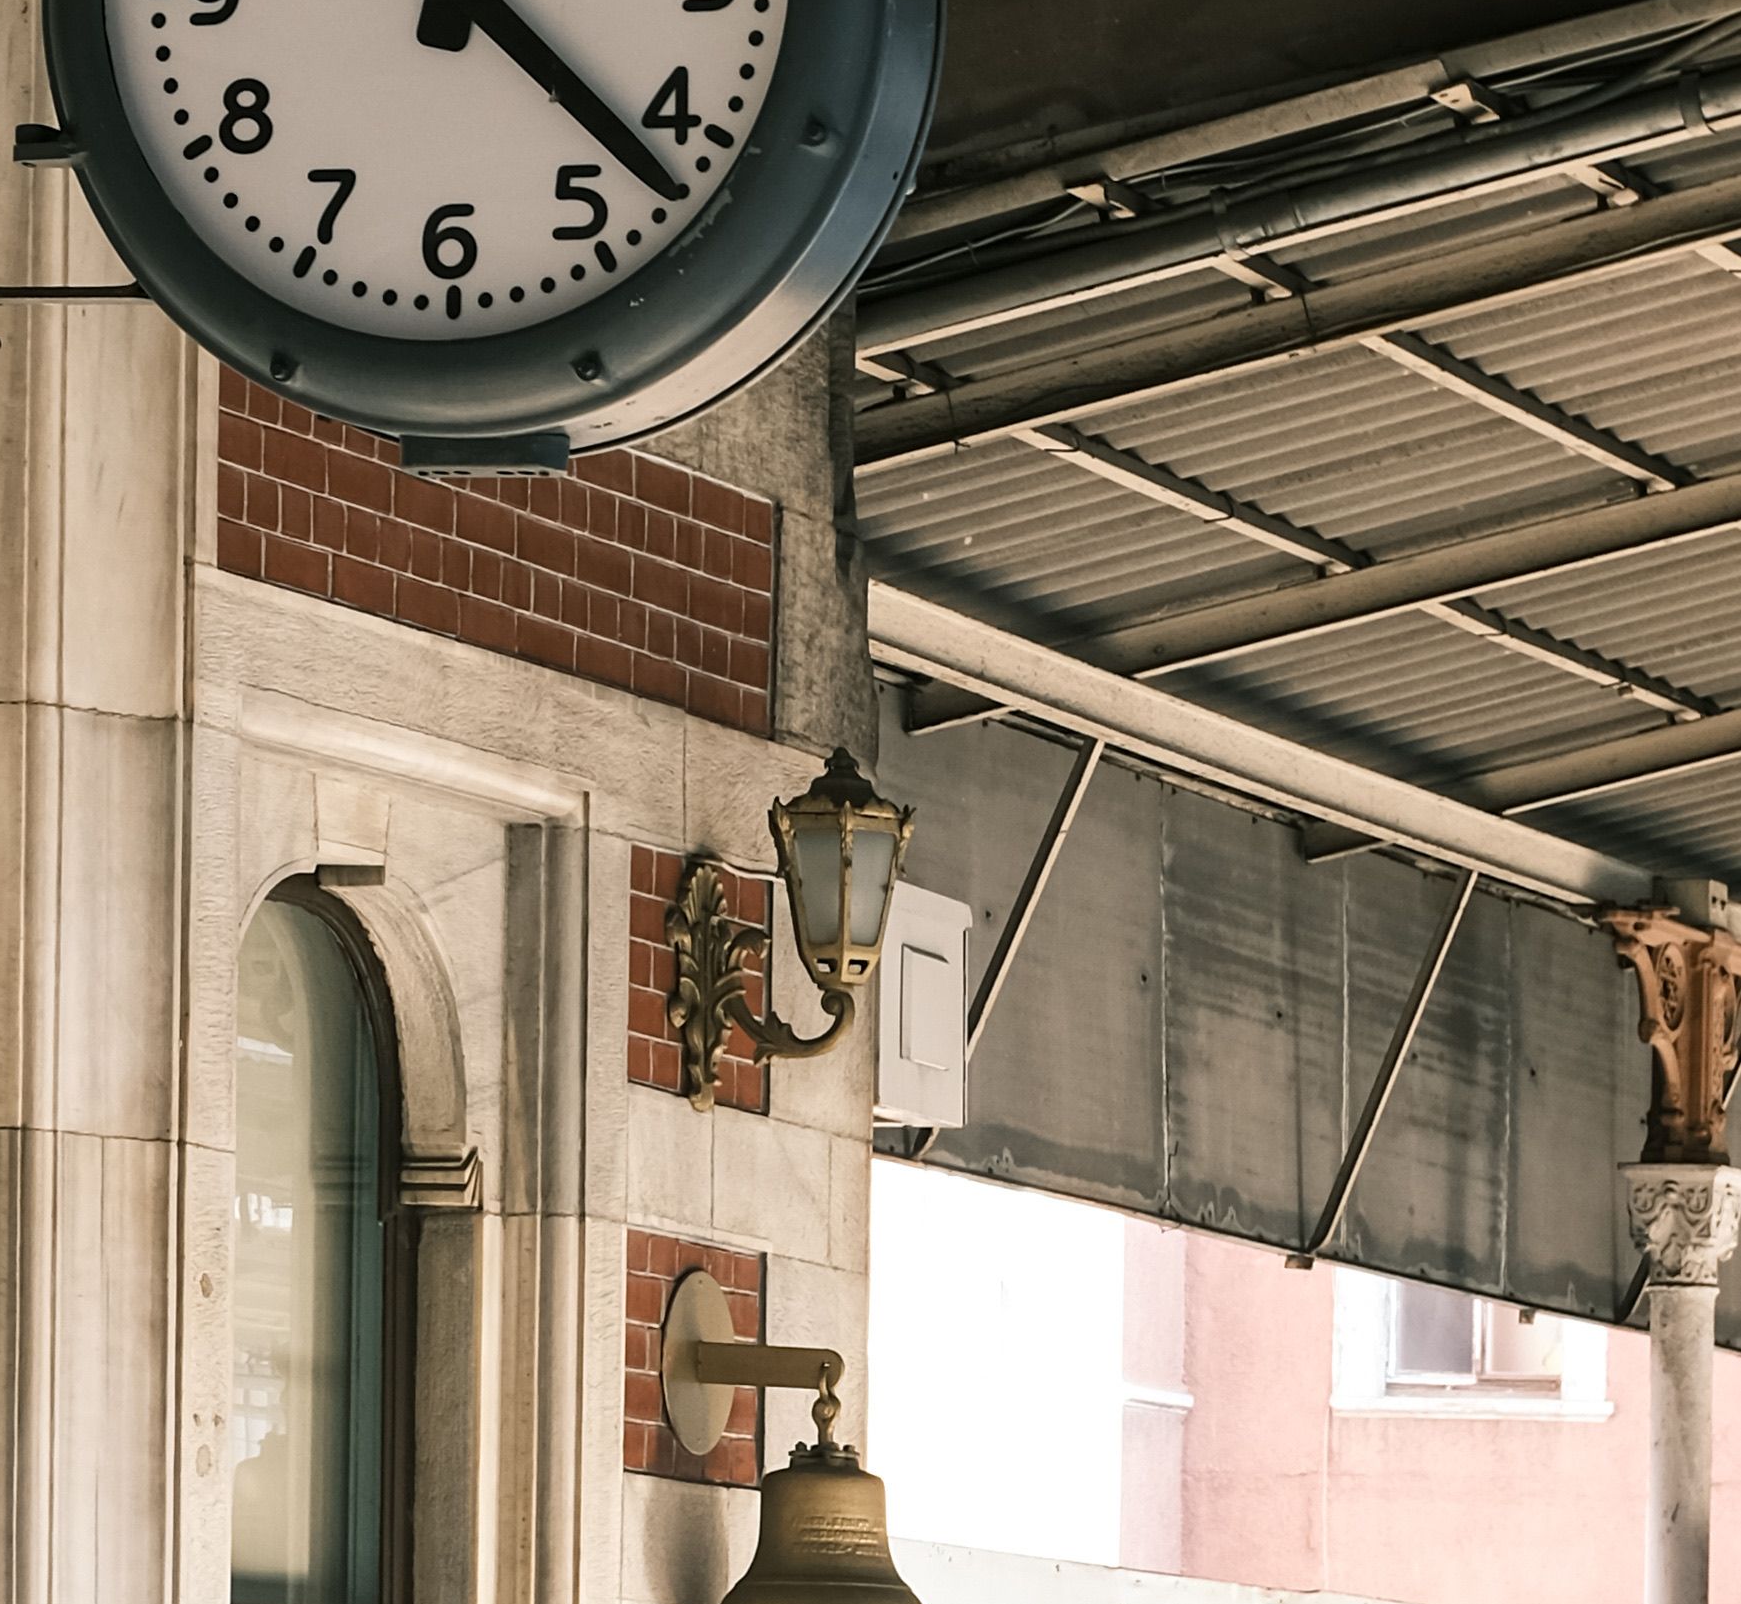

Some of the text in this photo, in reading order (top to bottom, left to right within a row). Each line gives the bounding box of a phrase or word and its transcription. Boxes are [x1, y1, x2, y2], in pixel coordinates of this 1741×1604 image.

[218, 77, 274, 155] 8
[640, 65, 703, 146] 4
[307, 168, 357, 245] 7
[551, 163, 609, 241] 5
[421, 203, 478, 281] 6
